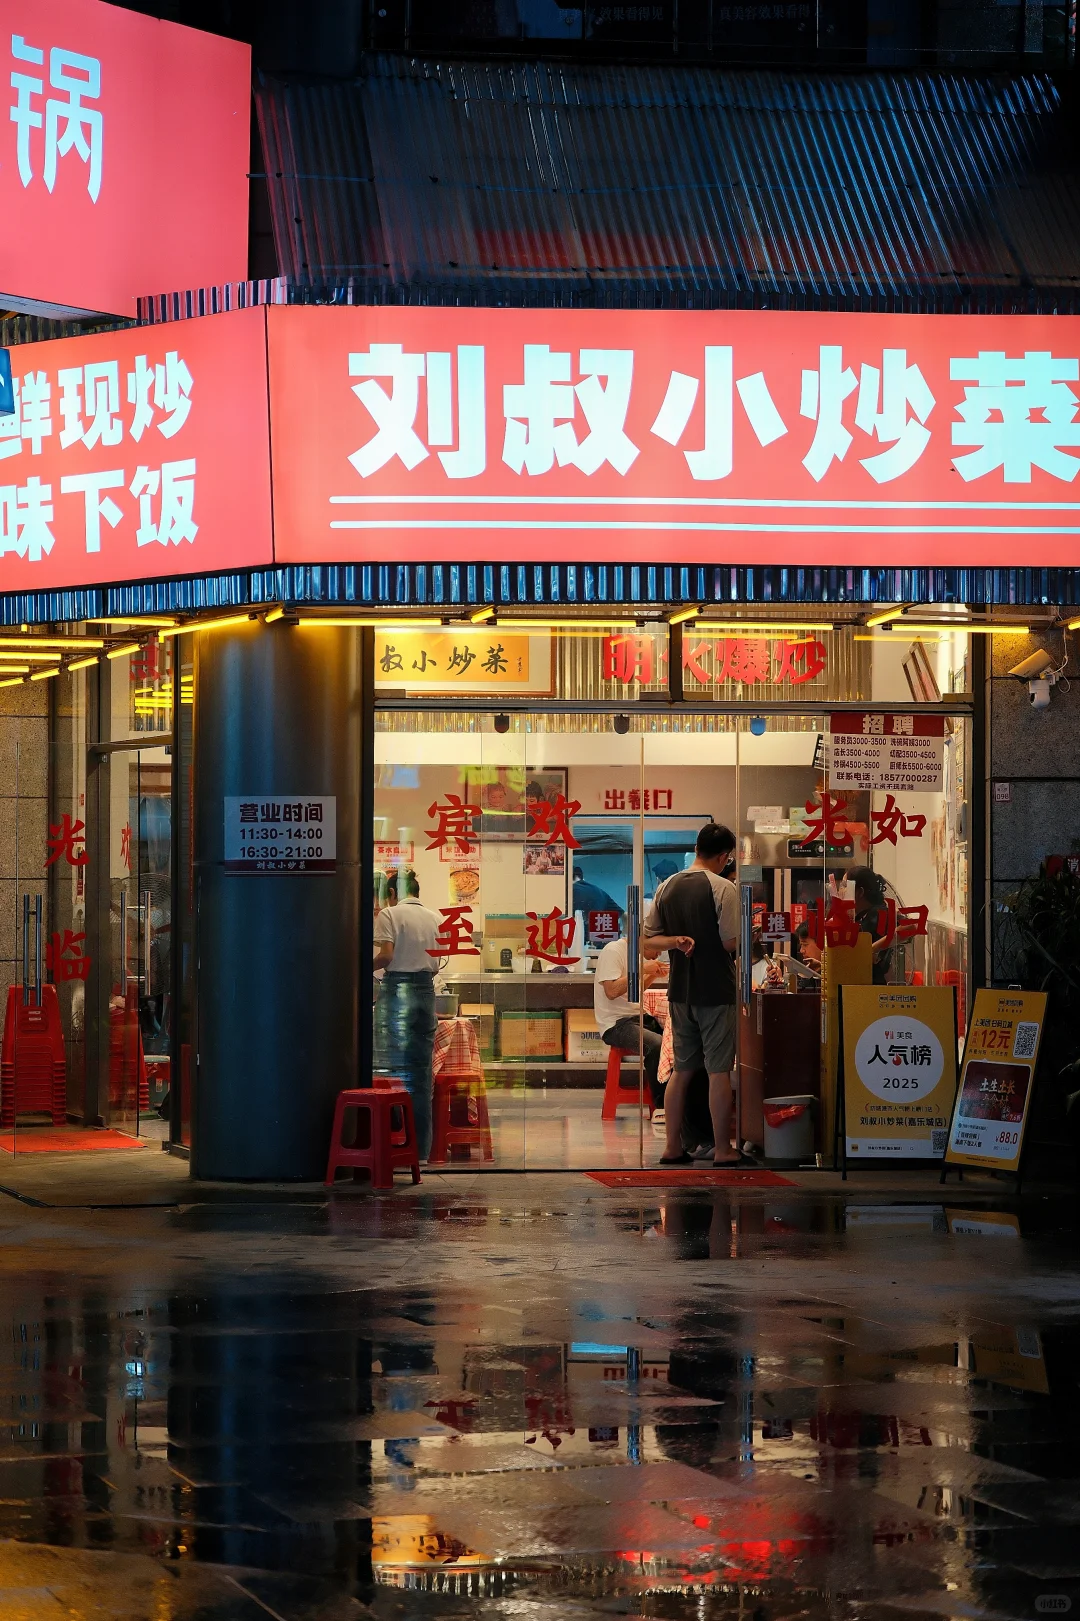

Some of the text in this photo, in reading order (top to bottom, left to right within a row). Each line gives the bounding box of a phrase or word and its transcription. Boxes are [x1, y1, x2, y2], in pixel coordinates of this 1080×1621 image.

[10, 34, 104, 204] 锅
[347, 343, 1080, 484] 刘叔小炒菜
[0, 458, 199, 562] 味下饭
[379, 643, 509, 675] 叔小炒菜
[603, 634, 827, 685] 明火爆炒
[862, 714, 914, 735] 招聘
[604, 788, 673, 810] 出餐口
[240, 803, 323, 822] 营业时间
[240, 828, 323, 840] 11:30-14:00
[240, 846, 323, 858] 16:30-21:00
[256, 861, 306, 869] 刘叔小炒菜
[595, 913, 613, 931] 推
[768, 914, 786, 932] 推
[897, 1031, 913, 1039] 美食
[981, 1029, 1011, 1049] 12元
[867, 1044, 931, 1066] 人气榜
[882, 1078, 919, 1089] 2025
